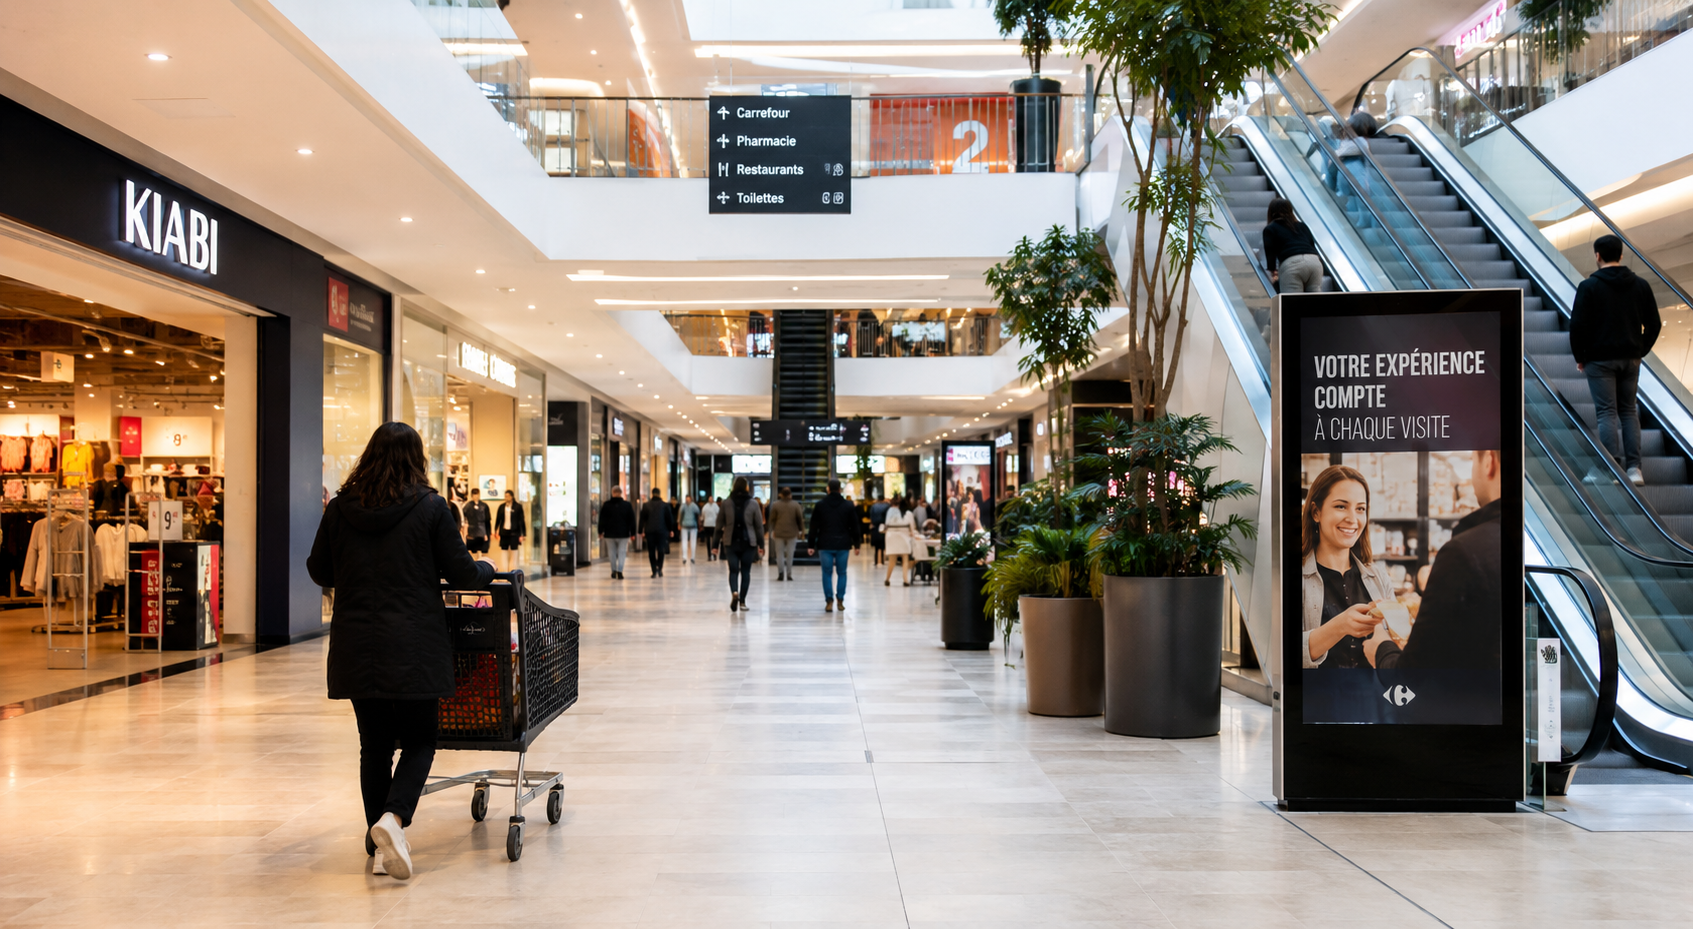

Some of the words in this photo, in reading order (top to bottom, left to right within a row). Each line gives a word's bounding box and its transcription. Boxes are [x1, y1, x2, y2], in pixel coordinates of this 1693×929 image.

[736, 107, 790, 119] Carrefour
[736, 135, 797, 147] Pharmacie
[952, 120, 989, 174] 2
[736, 163, 804, 175] Restaurants
[736, 192, 784, 204] Toilettes
[126, 179, 218, 275] KIABI
[1314, 354, 1370, 378] VOTRE
[1375, 348, 1485, 376] EXPÉRIENCE
[1314, 384, 1386, 409] COMPTE
[1314, 413, 1326, 441] À
[1330, 416, 1396, 442] CHAQUE
[1400, 414, 1451, 439] VISITE
